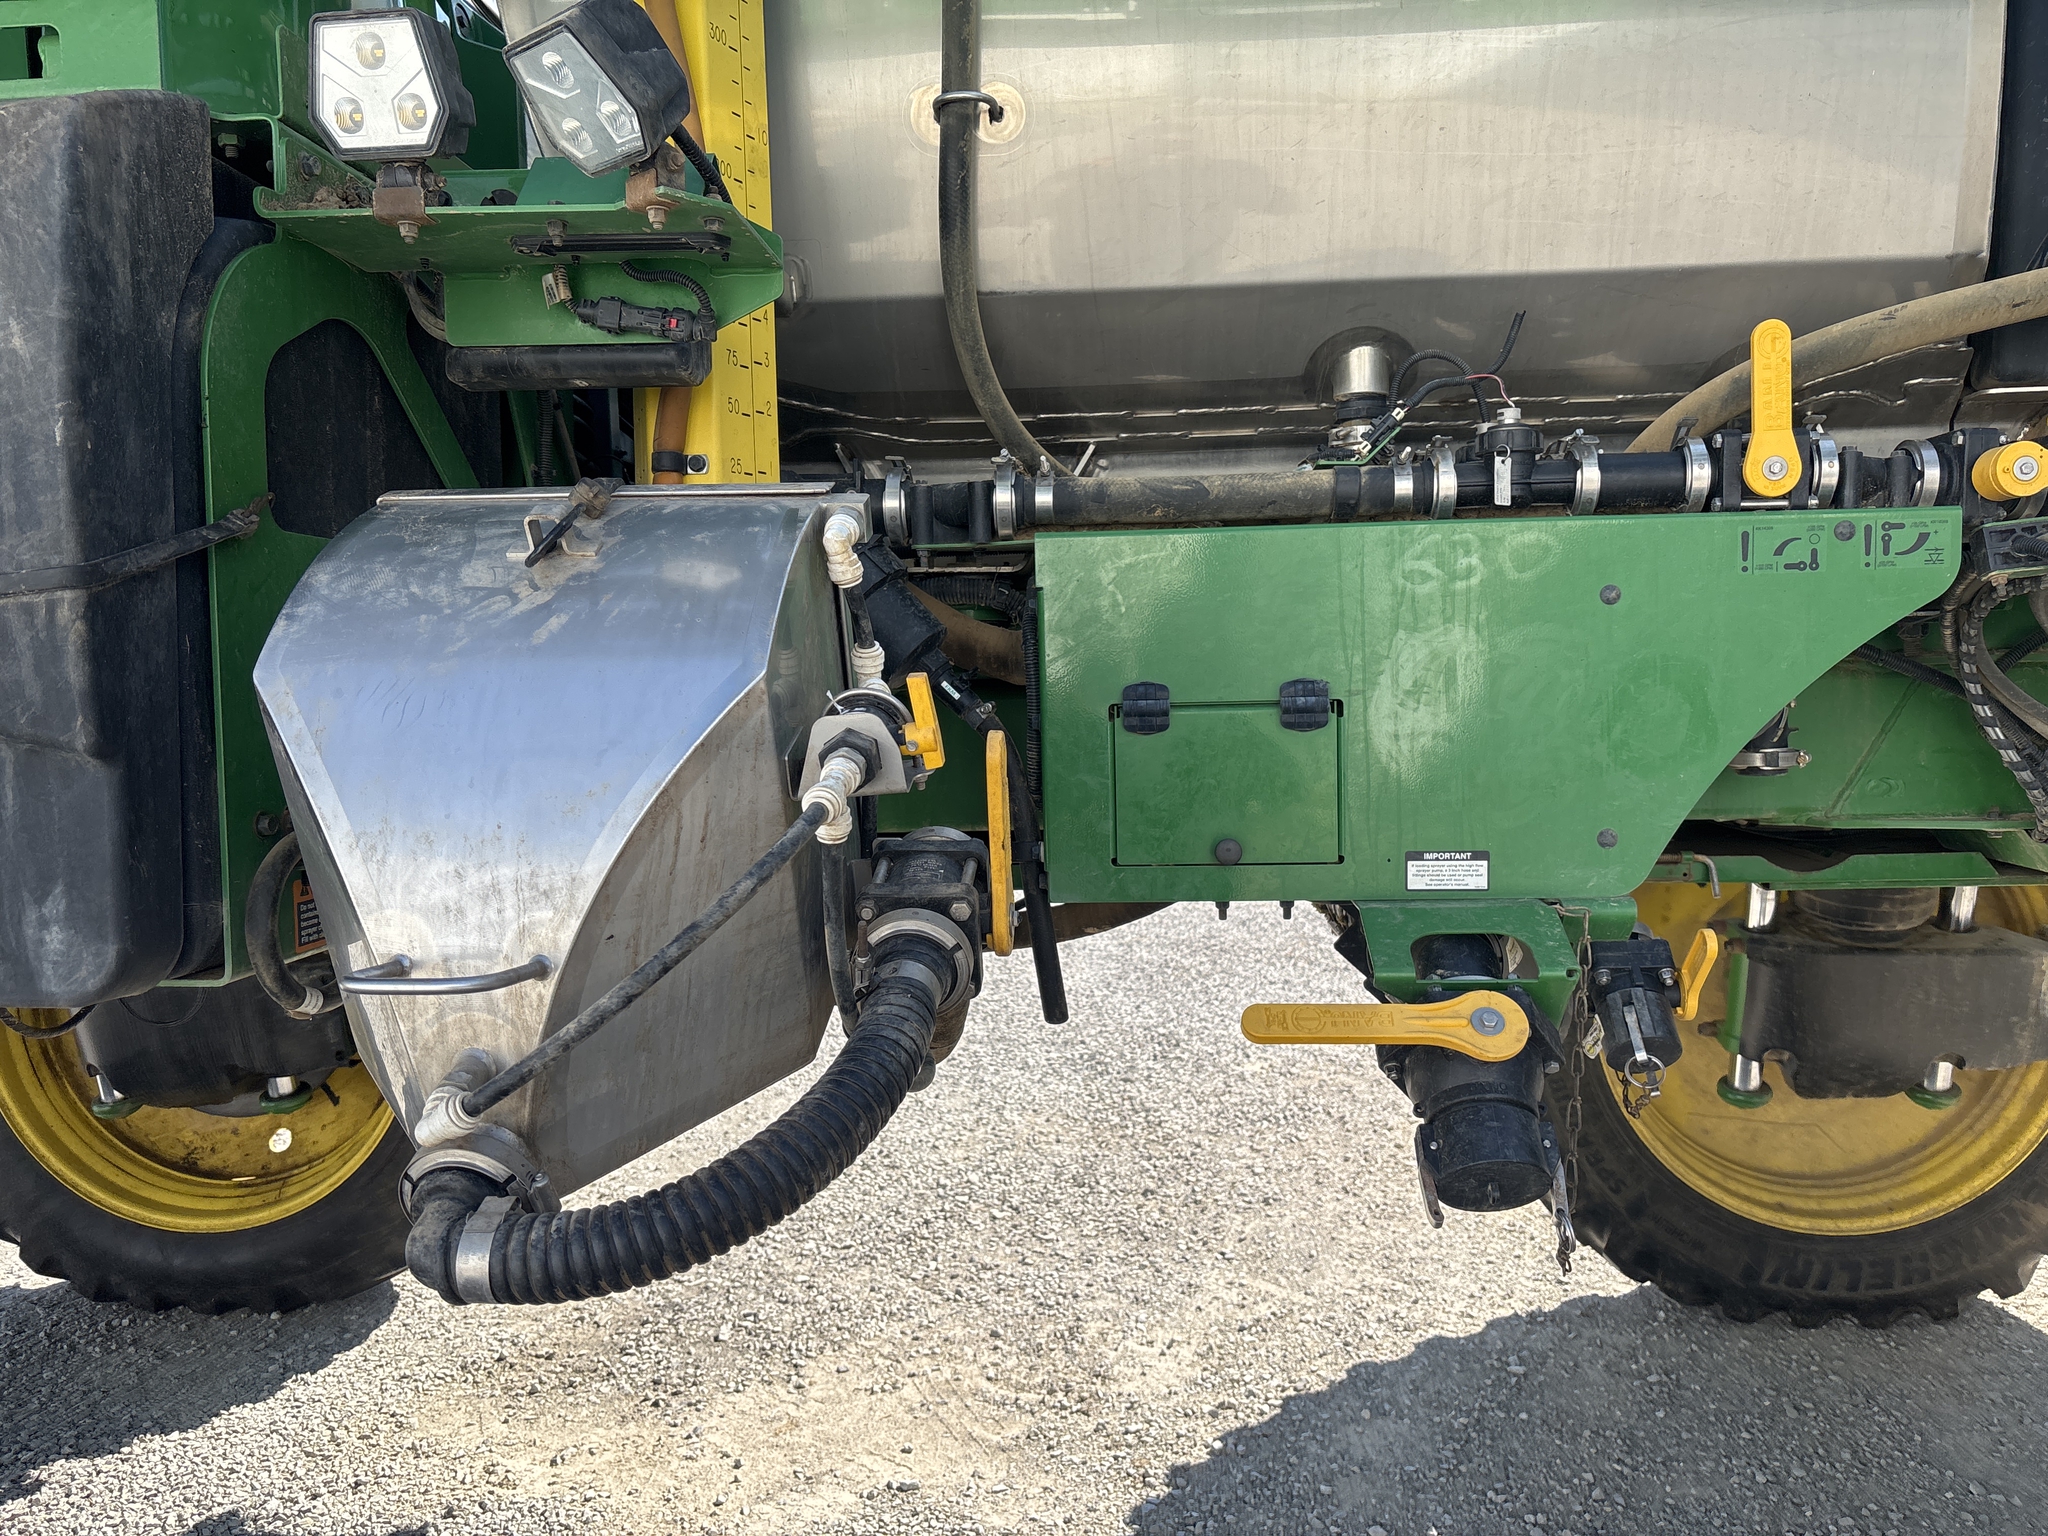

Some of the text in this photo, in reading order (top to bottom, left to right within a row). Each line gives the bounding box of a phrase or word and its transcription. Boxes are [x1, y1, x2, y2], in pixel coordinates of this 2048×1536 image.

[709, 21, 727, 46] 300
[757, 127, 768, 146] 10
[716, 157, 732, 180] 00
[763, 309, 769, 327] 4
[726, 348, 738, 367] 75
[763, 352, 770, 368] 3
[727, 396, 740, 415] 50
[766, 400, 772, 417] 2
[730, 457, 743, 475] 25
[1423, 852, 1472, 860] IMPORTANT
